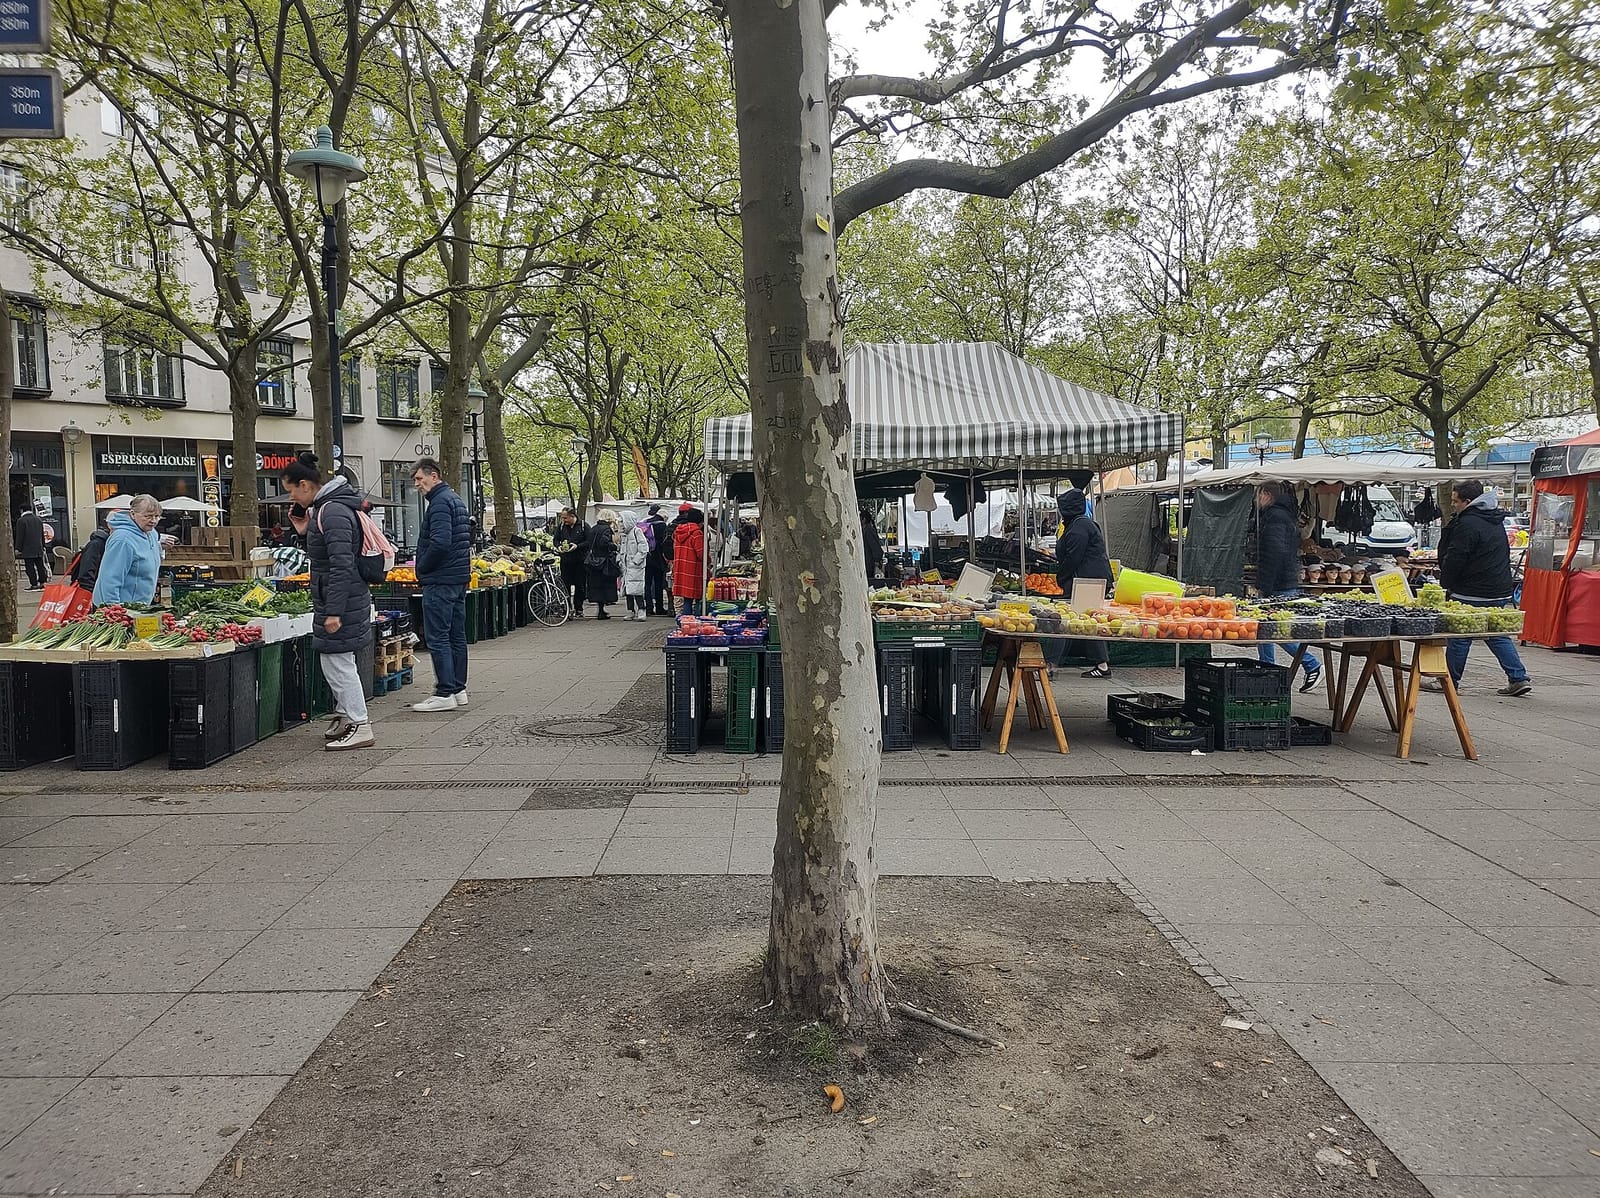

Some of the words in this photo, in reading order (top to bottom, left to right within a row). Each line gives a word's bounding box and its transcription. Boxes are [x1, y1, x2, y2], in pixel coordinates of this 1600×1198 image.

[10, 85, 41, 99] 350m
[12, 102, 41, 115] 100m
[101, 453, 157, 466] ESPRESSO
[159, 455, 196, 467] HOUSE
